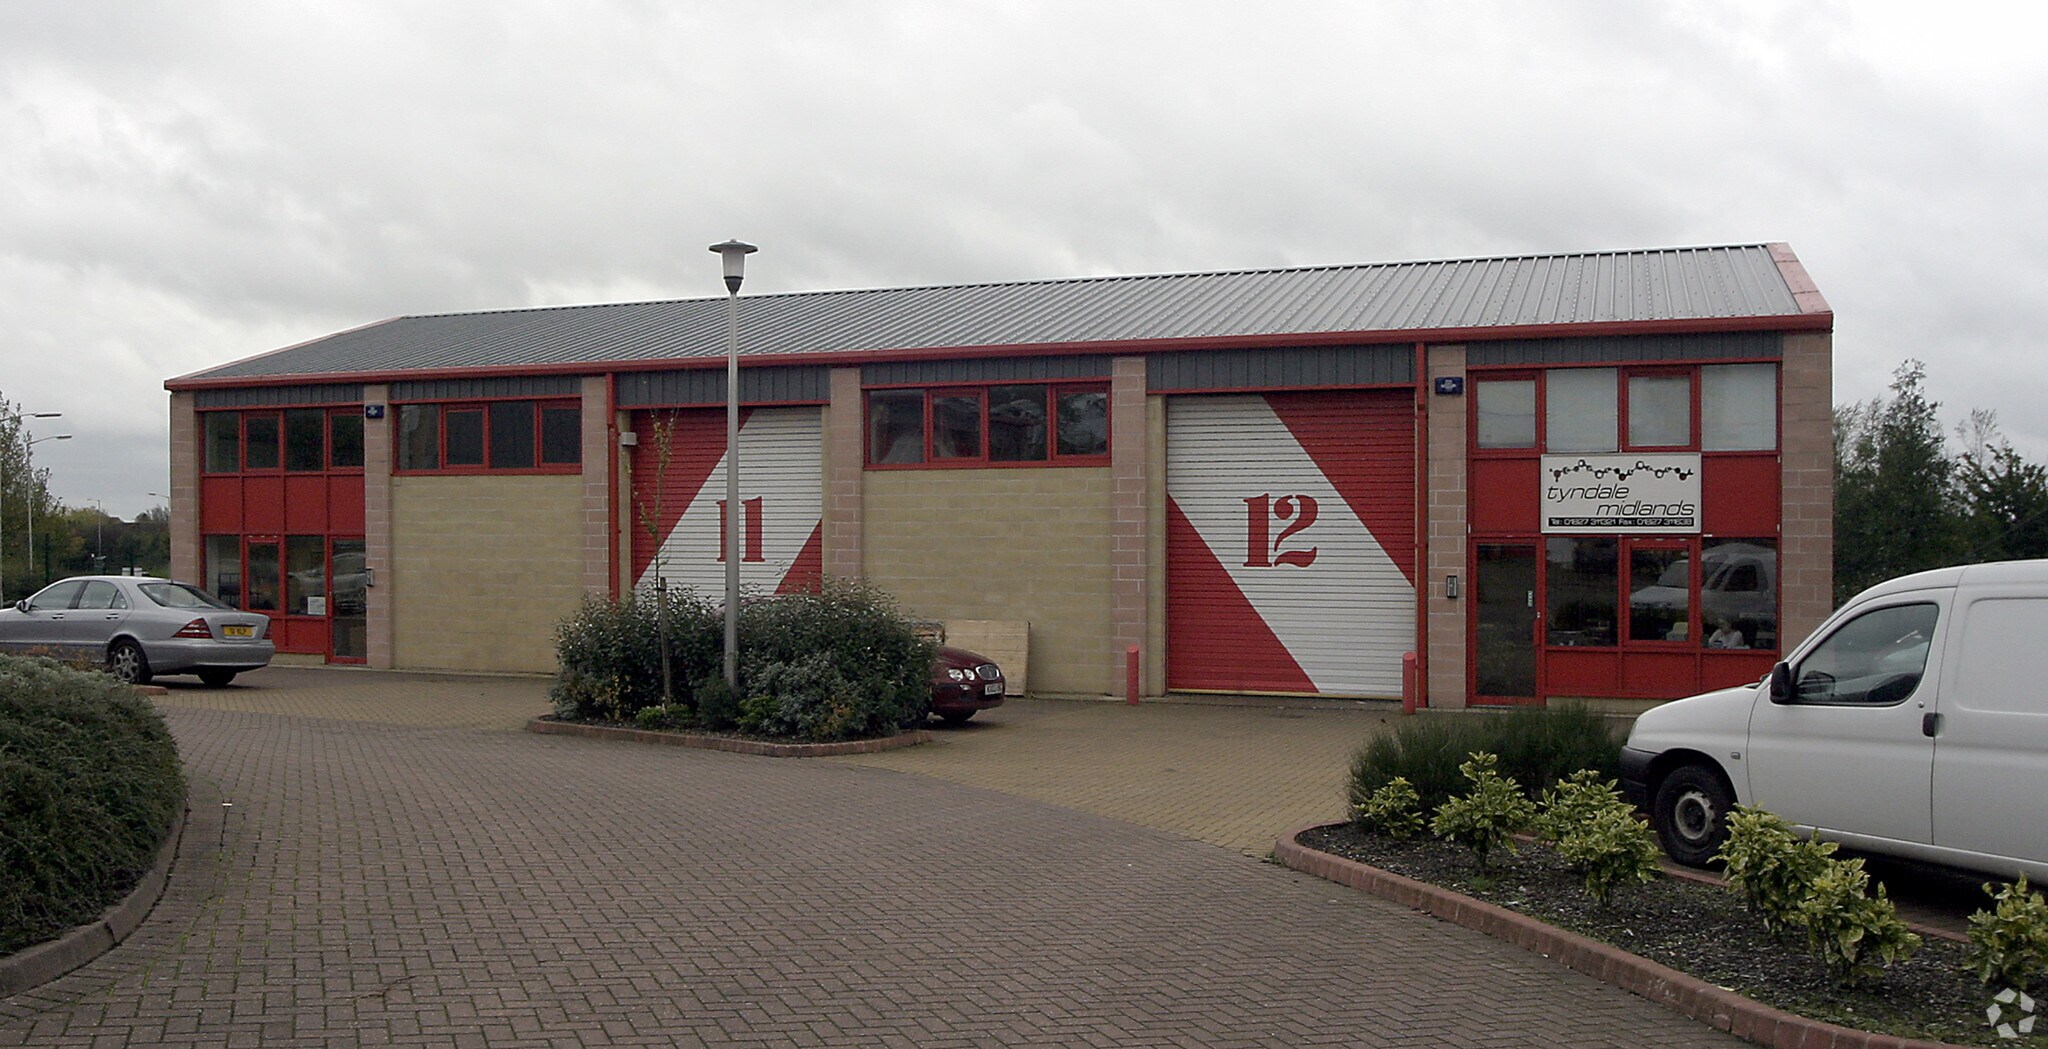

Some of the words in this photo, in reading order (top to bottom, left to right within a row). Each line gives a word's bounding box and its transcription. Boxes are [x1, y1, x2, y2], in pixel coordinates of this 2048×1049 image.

[1547, 484, 1630, 503] tyndale
[1596, 500, 1695, 516] midlands
[1243, 493, 1318, 567] 12
[1563, 518, 1589, 526] 01827
[1618, 518, 1636, 526] Fax:
[1636, 518, 1662, 526] 01827
